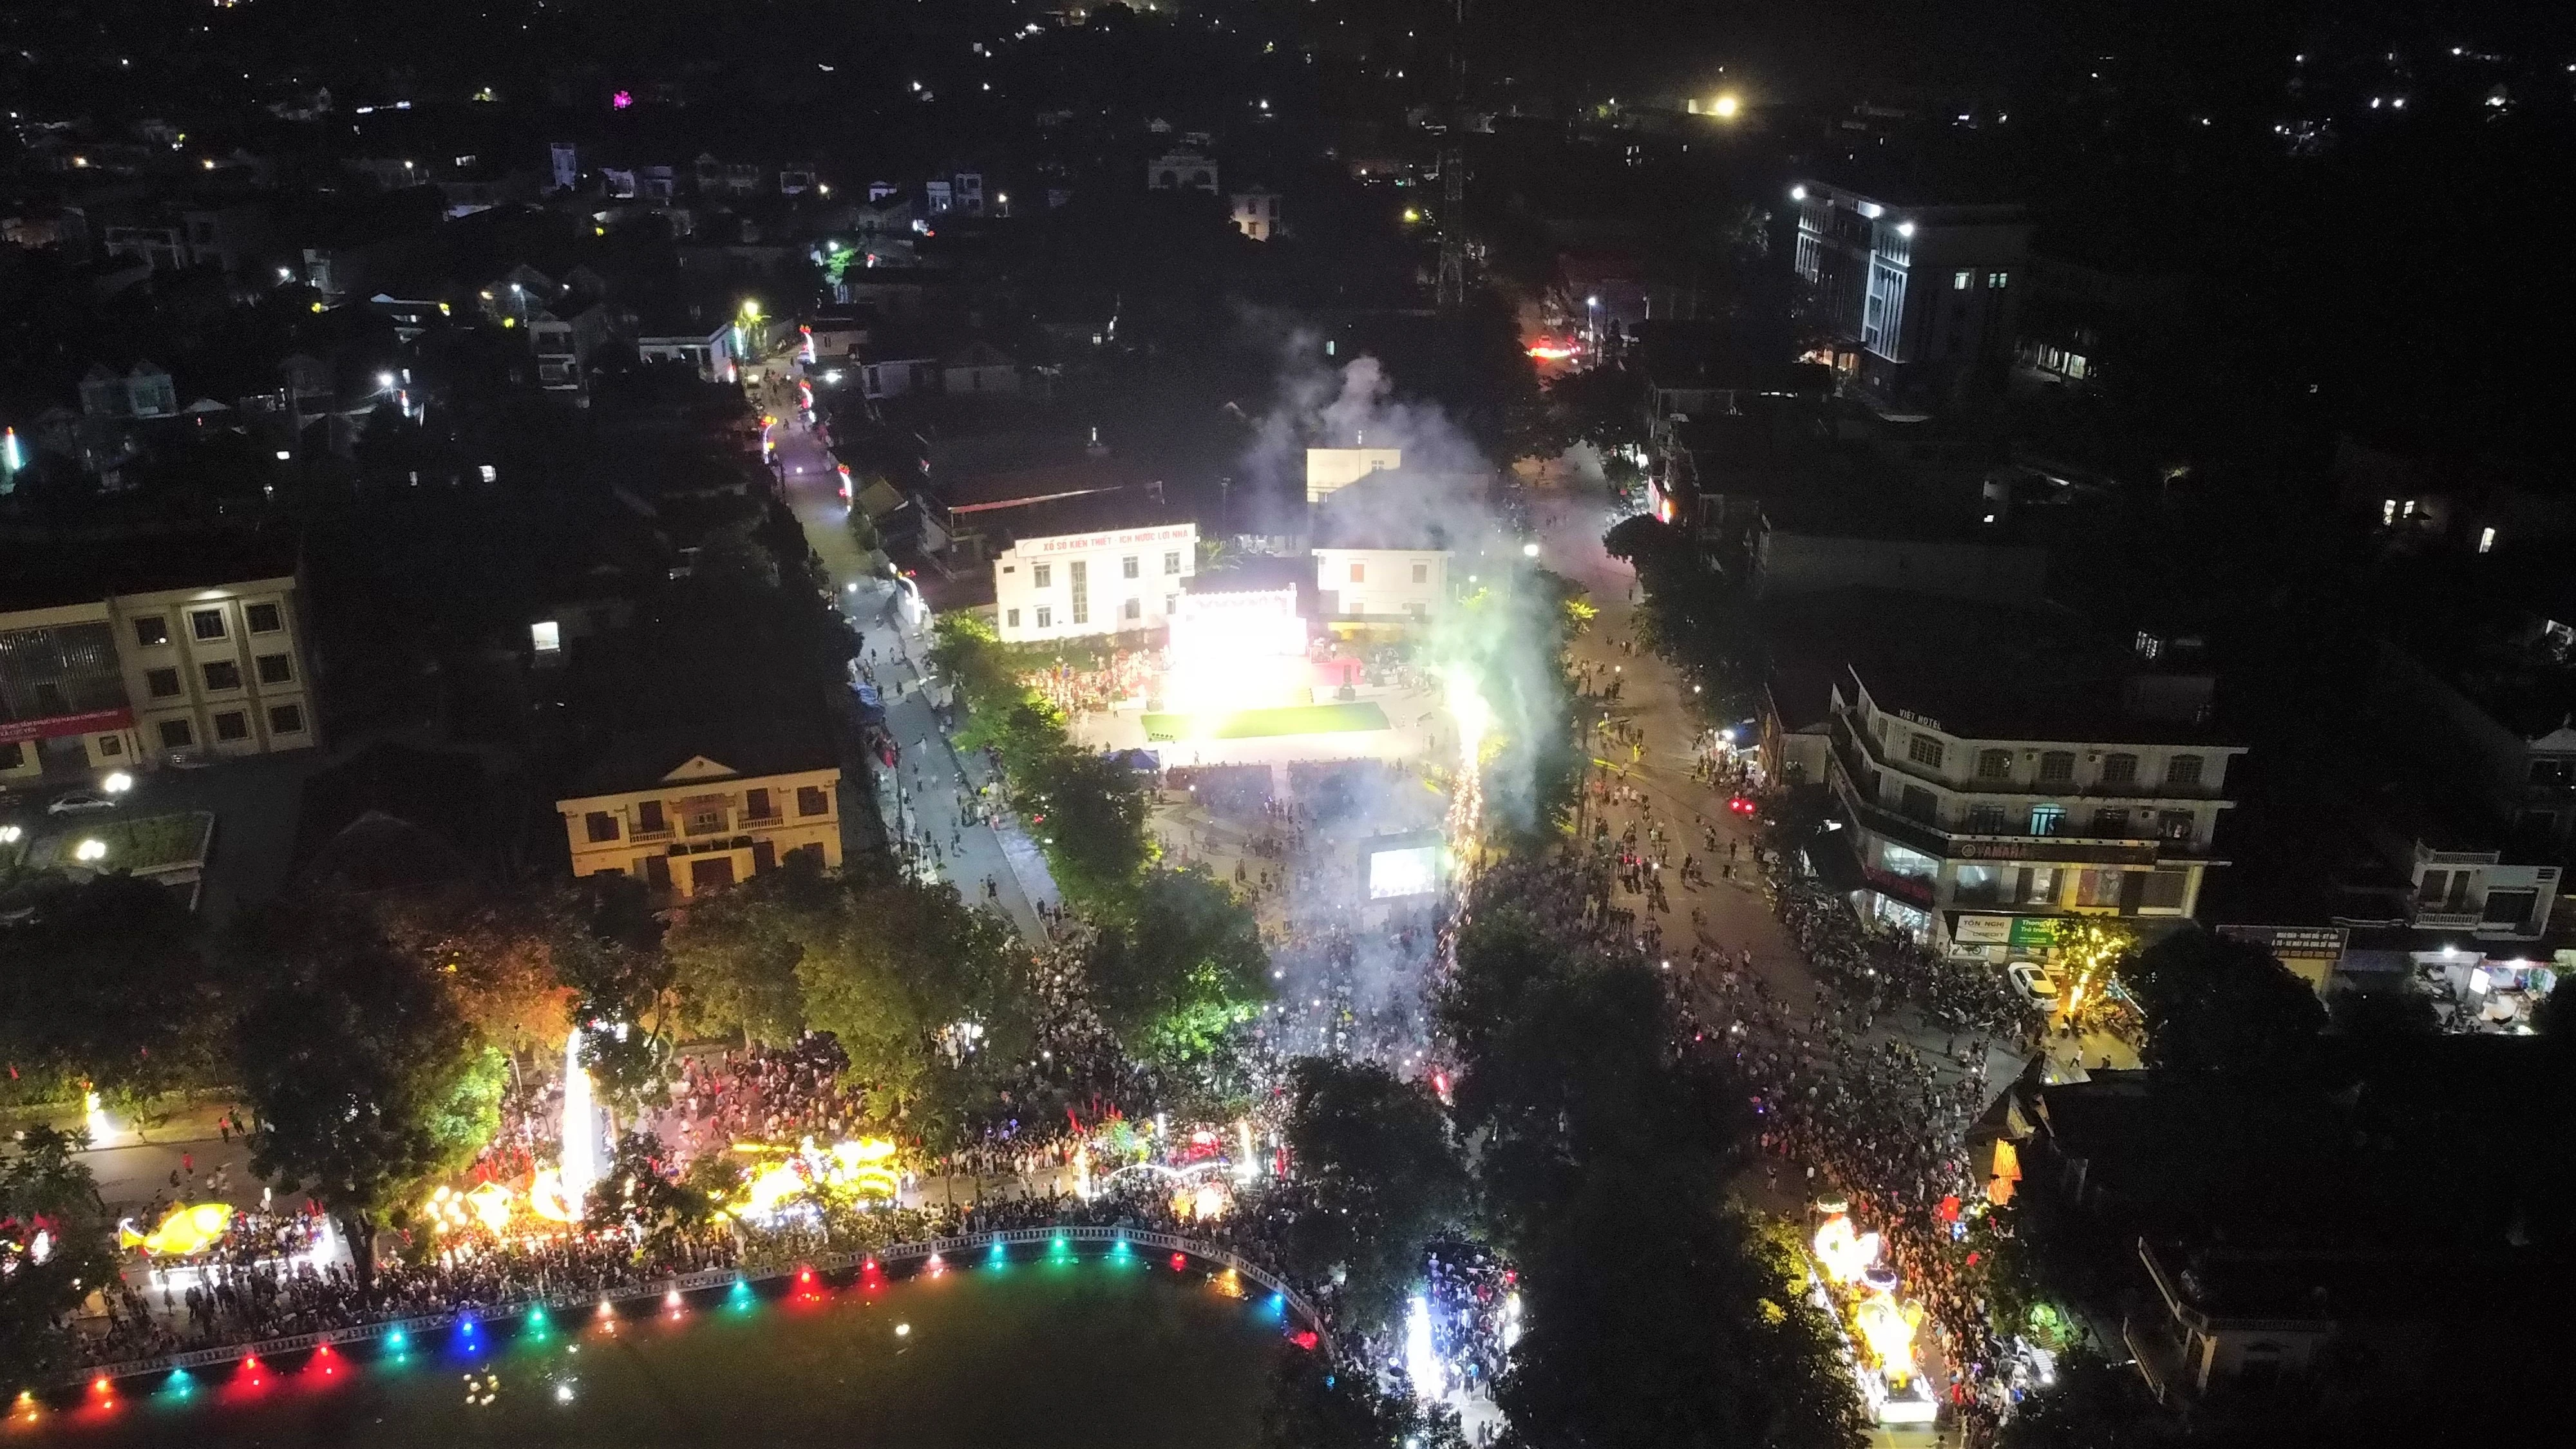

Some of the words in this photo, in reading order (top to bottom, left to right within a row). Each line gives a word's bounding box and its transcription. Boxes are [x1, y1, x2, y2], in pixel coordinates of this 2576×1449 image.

[1070, 536, 1088, 549] KIẾN
[1091, 535, 1112, 547] THIẾT
[1918, 715, 1942, 731] HOTEL
